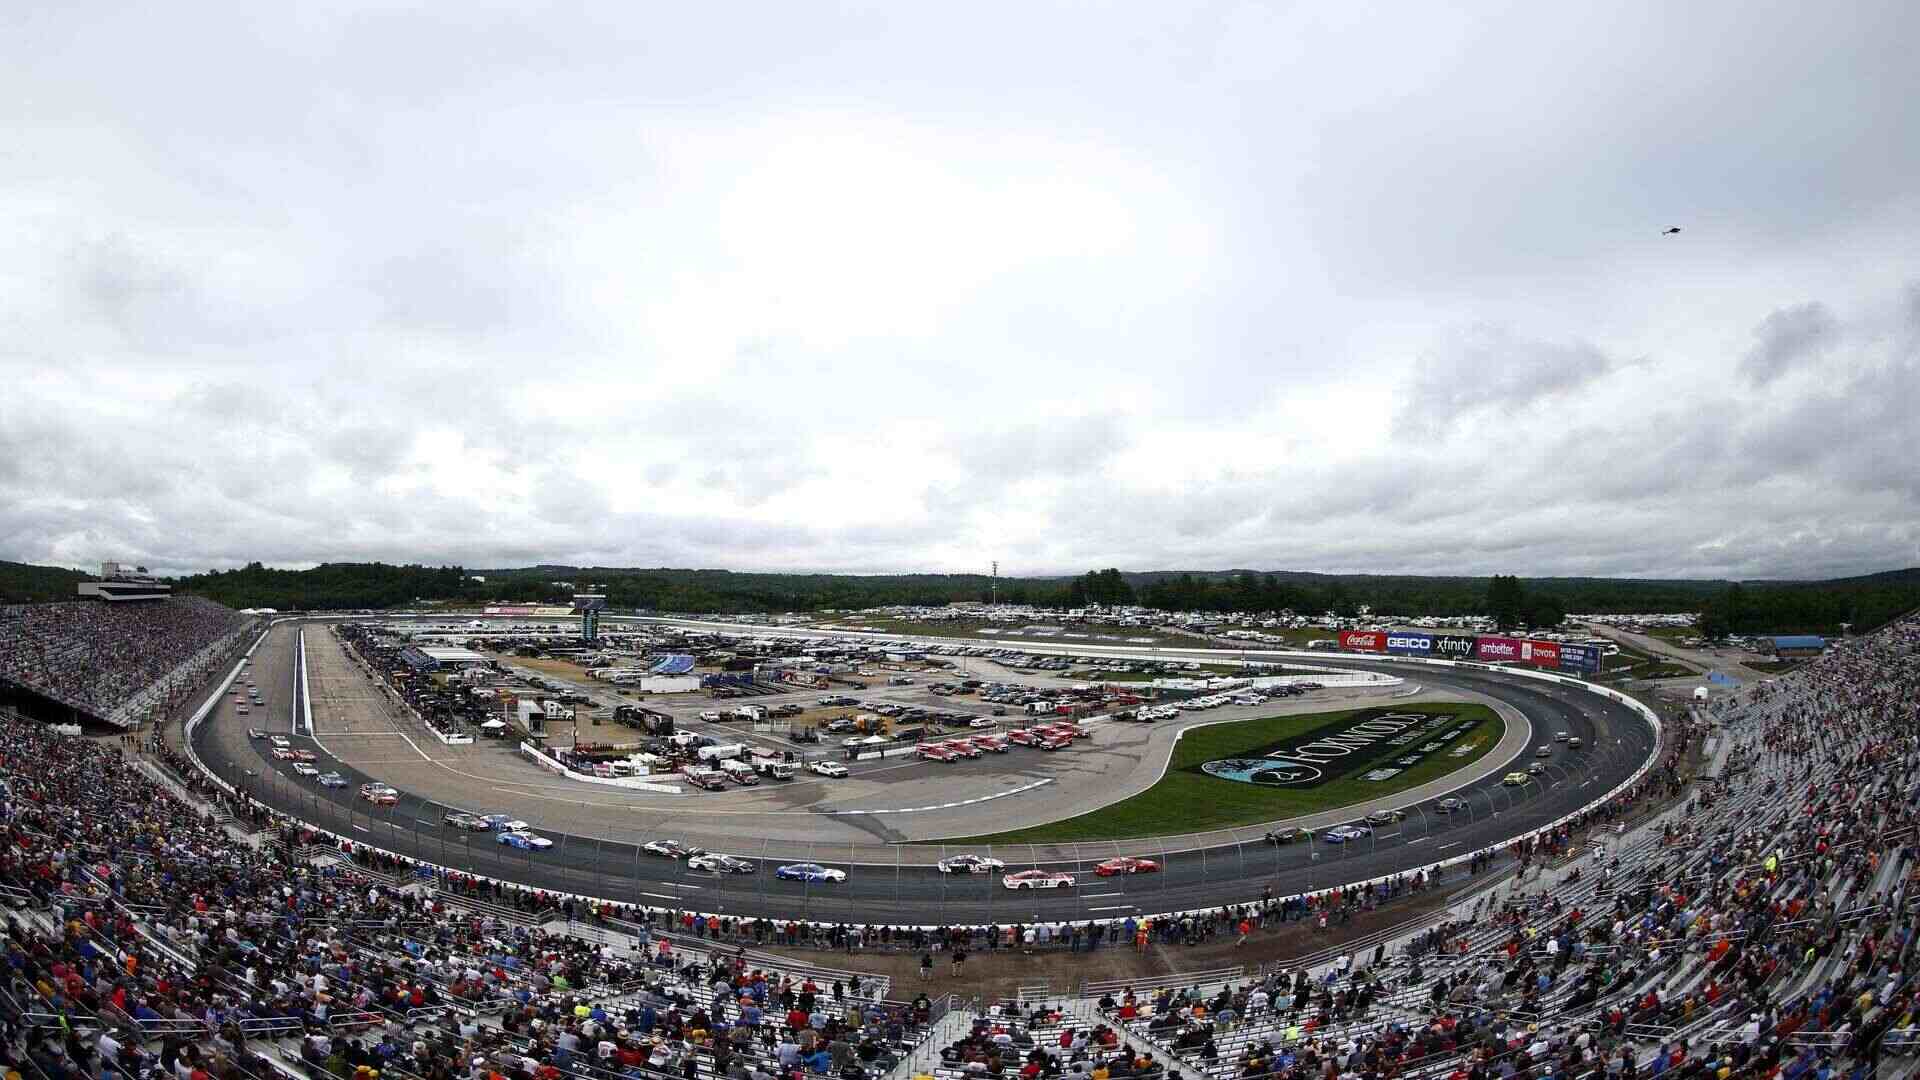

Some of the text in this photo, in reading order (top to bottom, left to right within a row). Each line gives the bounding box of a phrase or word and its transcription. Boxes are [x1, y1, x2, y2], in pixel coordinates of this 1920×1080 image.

[1387, 637, 1430, 649] GEICO
[1437, 637, 1472, 654] xfinity
[1480, 642, 1514, 655] ambetter
[1533, 648, 1556, 657] TOYOTA
[1263, 712, 1427, 763] FOXWOODS
